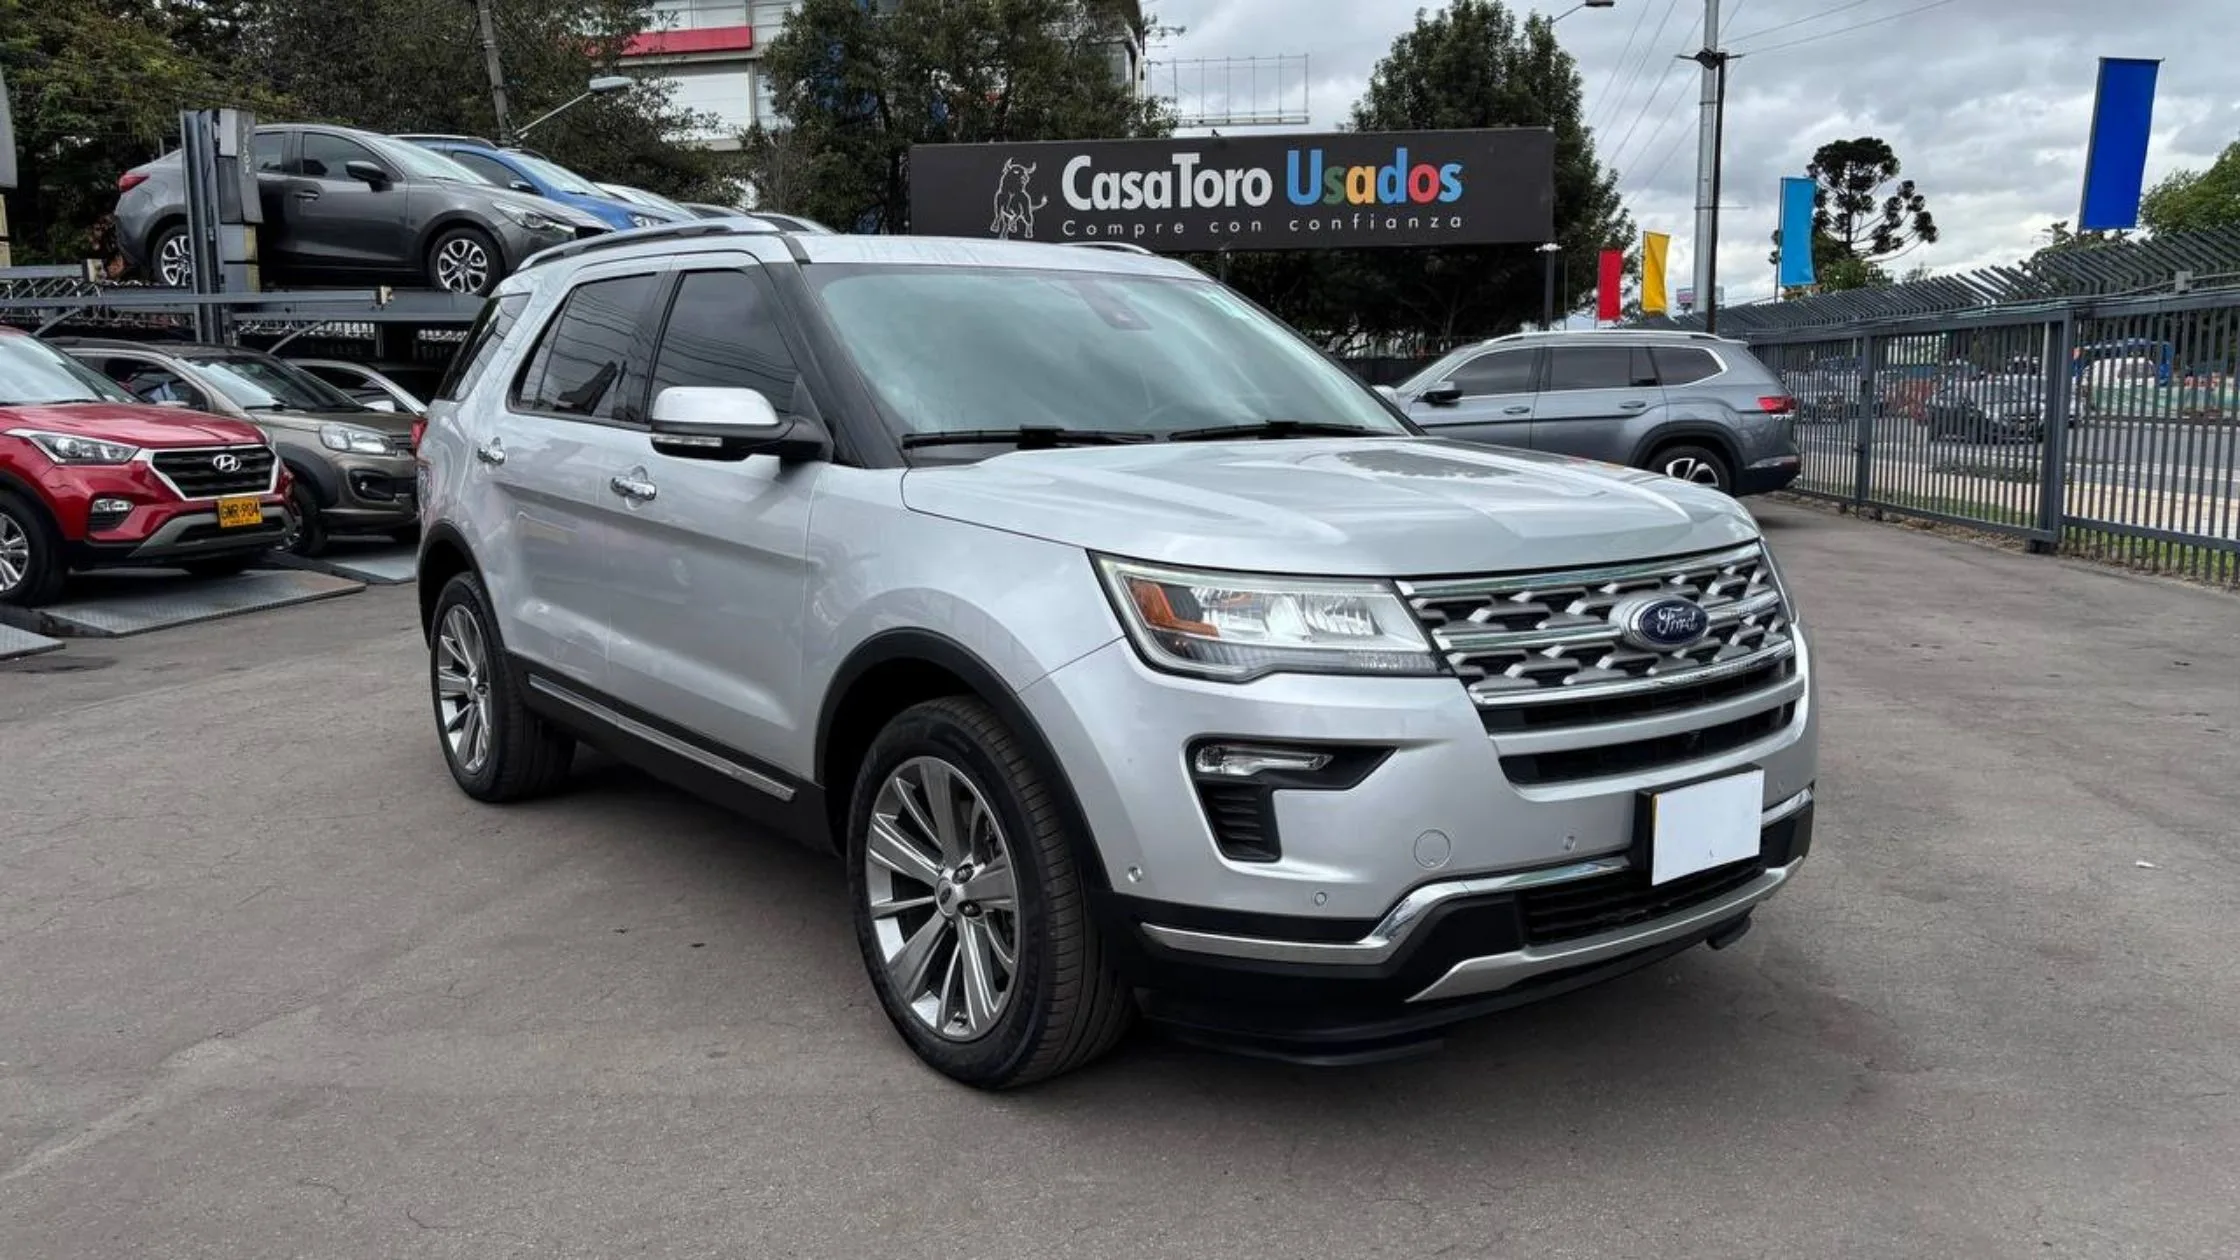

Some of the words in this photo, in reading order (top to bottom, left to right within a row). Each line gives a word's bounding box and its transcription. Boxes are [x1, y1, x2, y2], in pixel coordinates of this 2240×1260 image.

[1062, 153, 1273, 211] CasaToro
[1287, 148, 1463, 205] Usados
[1062, 220, 1184, 238] Compre
[1210, 221, 1261, 234] con
[1289, 213, 1461, 231] confianza
[1657, 606, 1697, 634] Ford
